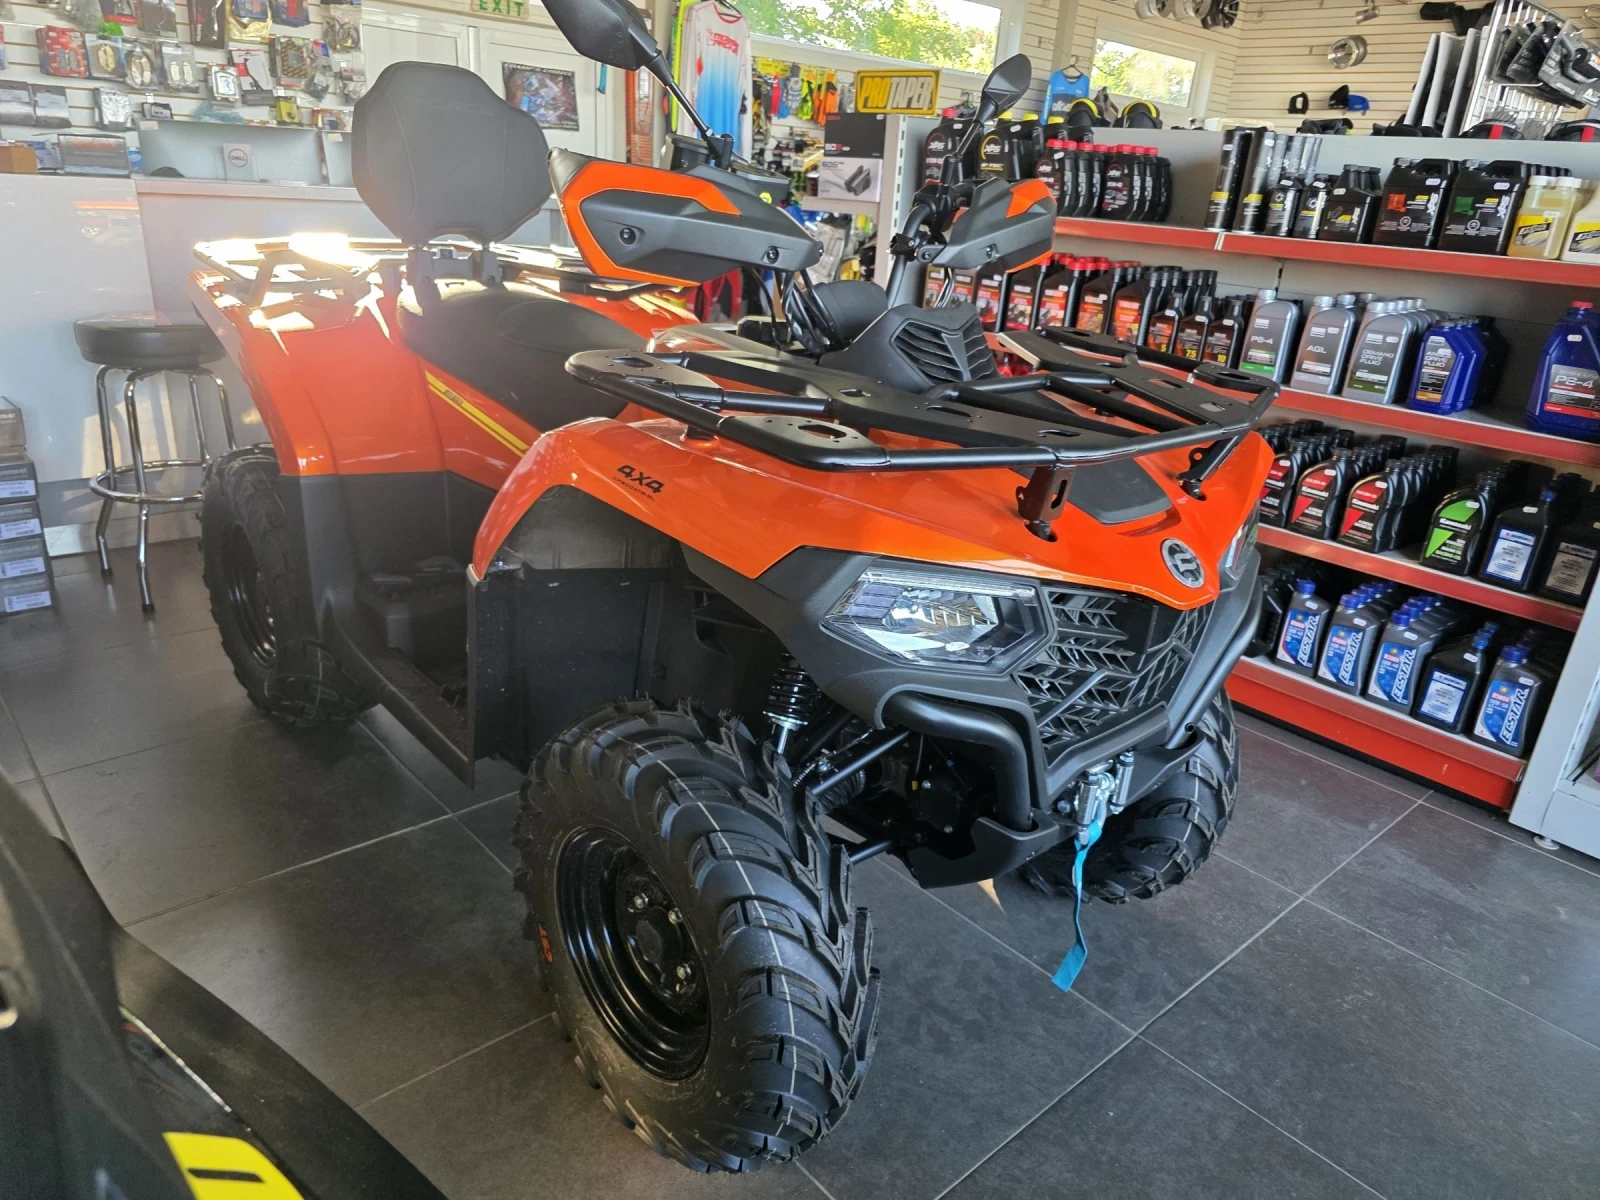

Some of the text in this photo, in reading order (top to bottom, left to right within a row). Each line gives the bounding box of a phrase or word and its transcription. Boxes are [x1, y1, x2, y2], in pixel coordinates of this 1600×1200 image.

[479, 0, 524, 16] EXIT
[1250, 335, 1274, 345] PS-4
[1160, 343, 1167, 353] 5
[1306, 344, 1327, 354] AGL
[1217, 353, 1227, 363] 10
[1360, 354, 1383, 362] DRIVE
[1362, 349, 1394, 359] DEMAND
[1359, 358, 1382, 366] FLUID
[1554, 375, 1594, 389] PS-4
[1298, 615, 1318, 665] ECSTAR
[1340, 632, 1361, 683] ECSTAR
[1393, 649, 1414, 702] ECSTAR
[1502, 687, 1525, 743] ECSTAR
